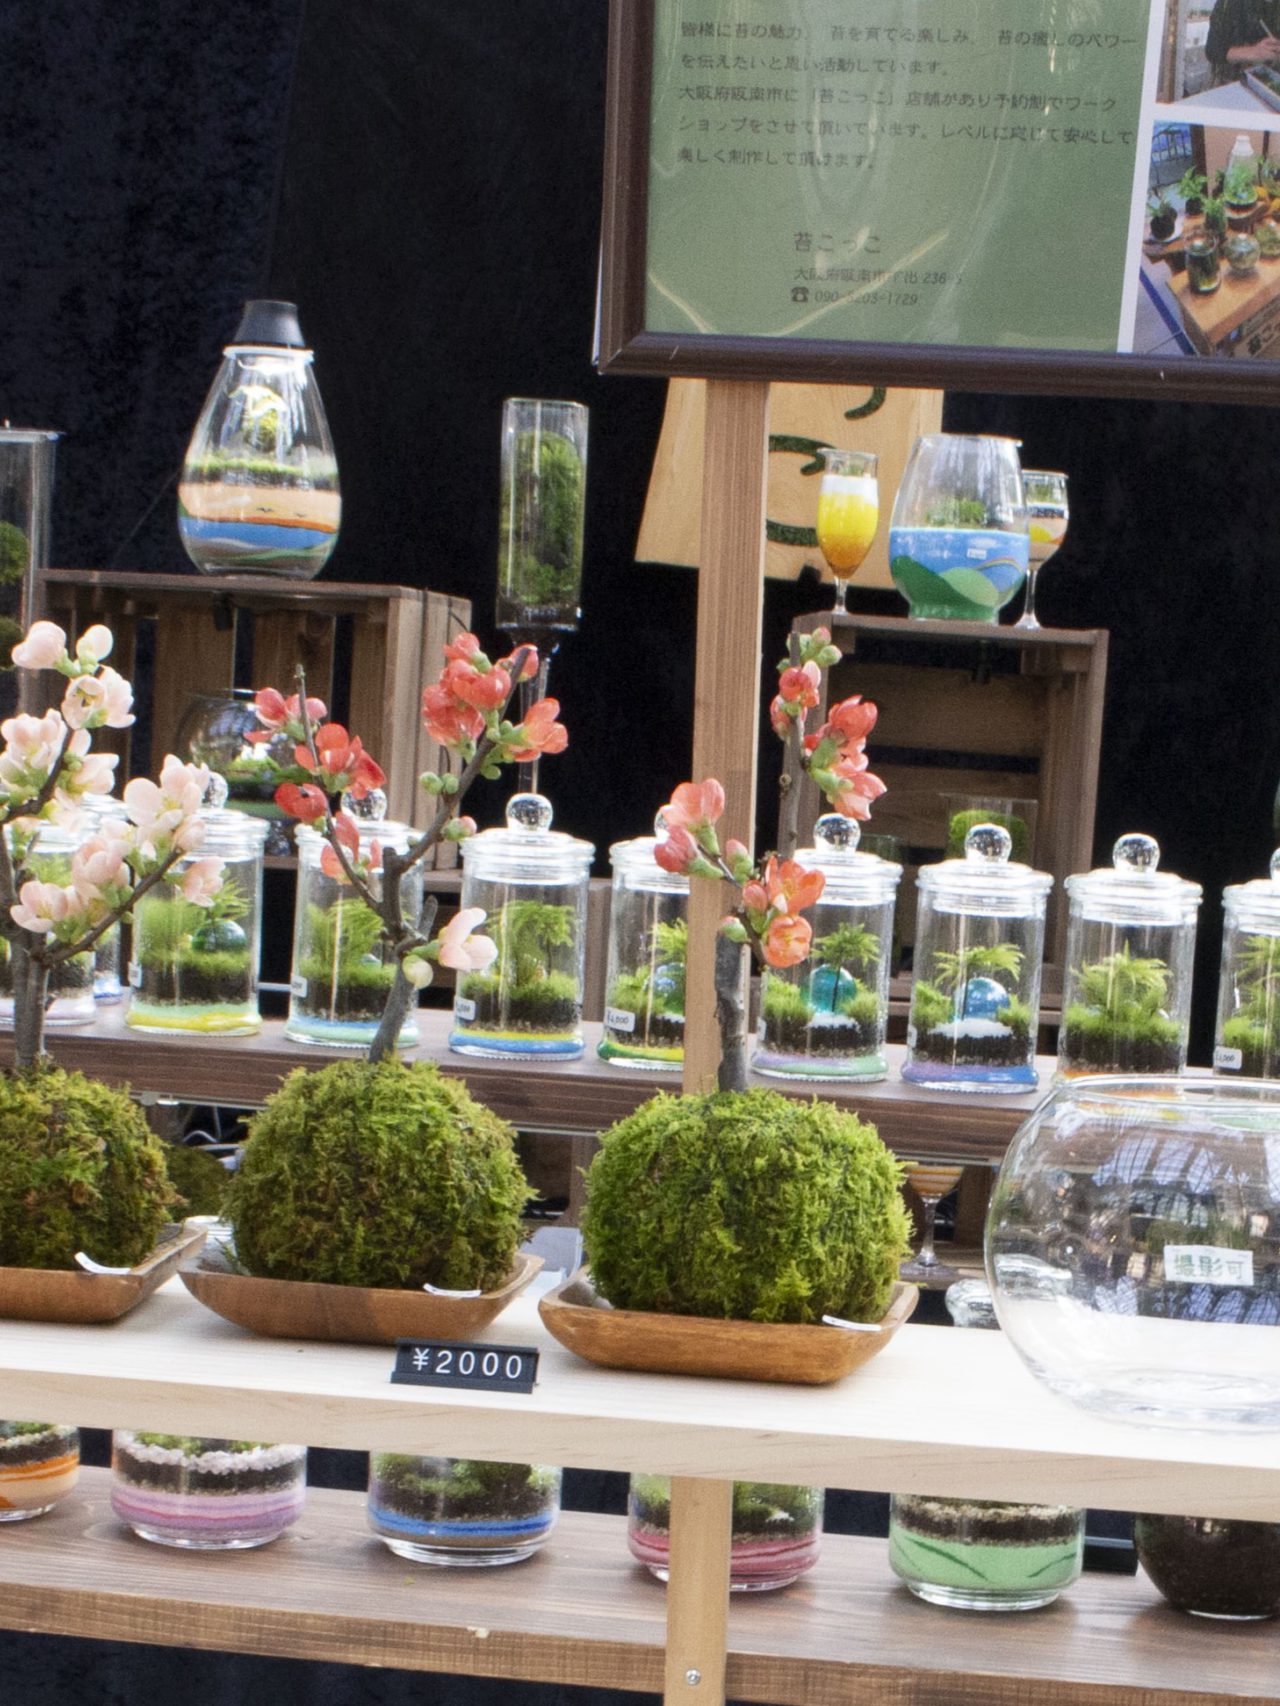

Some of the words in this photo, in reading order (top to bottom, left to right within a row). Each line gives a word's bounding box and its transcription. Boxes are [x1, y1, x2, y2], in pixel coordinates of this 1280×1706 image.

[794, 231, 880, 254] 苔こっこ
[1174, 1254, 1244, 1280] 撮影可
[412, 1347, 523, 1379] ¥2000
